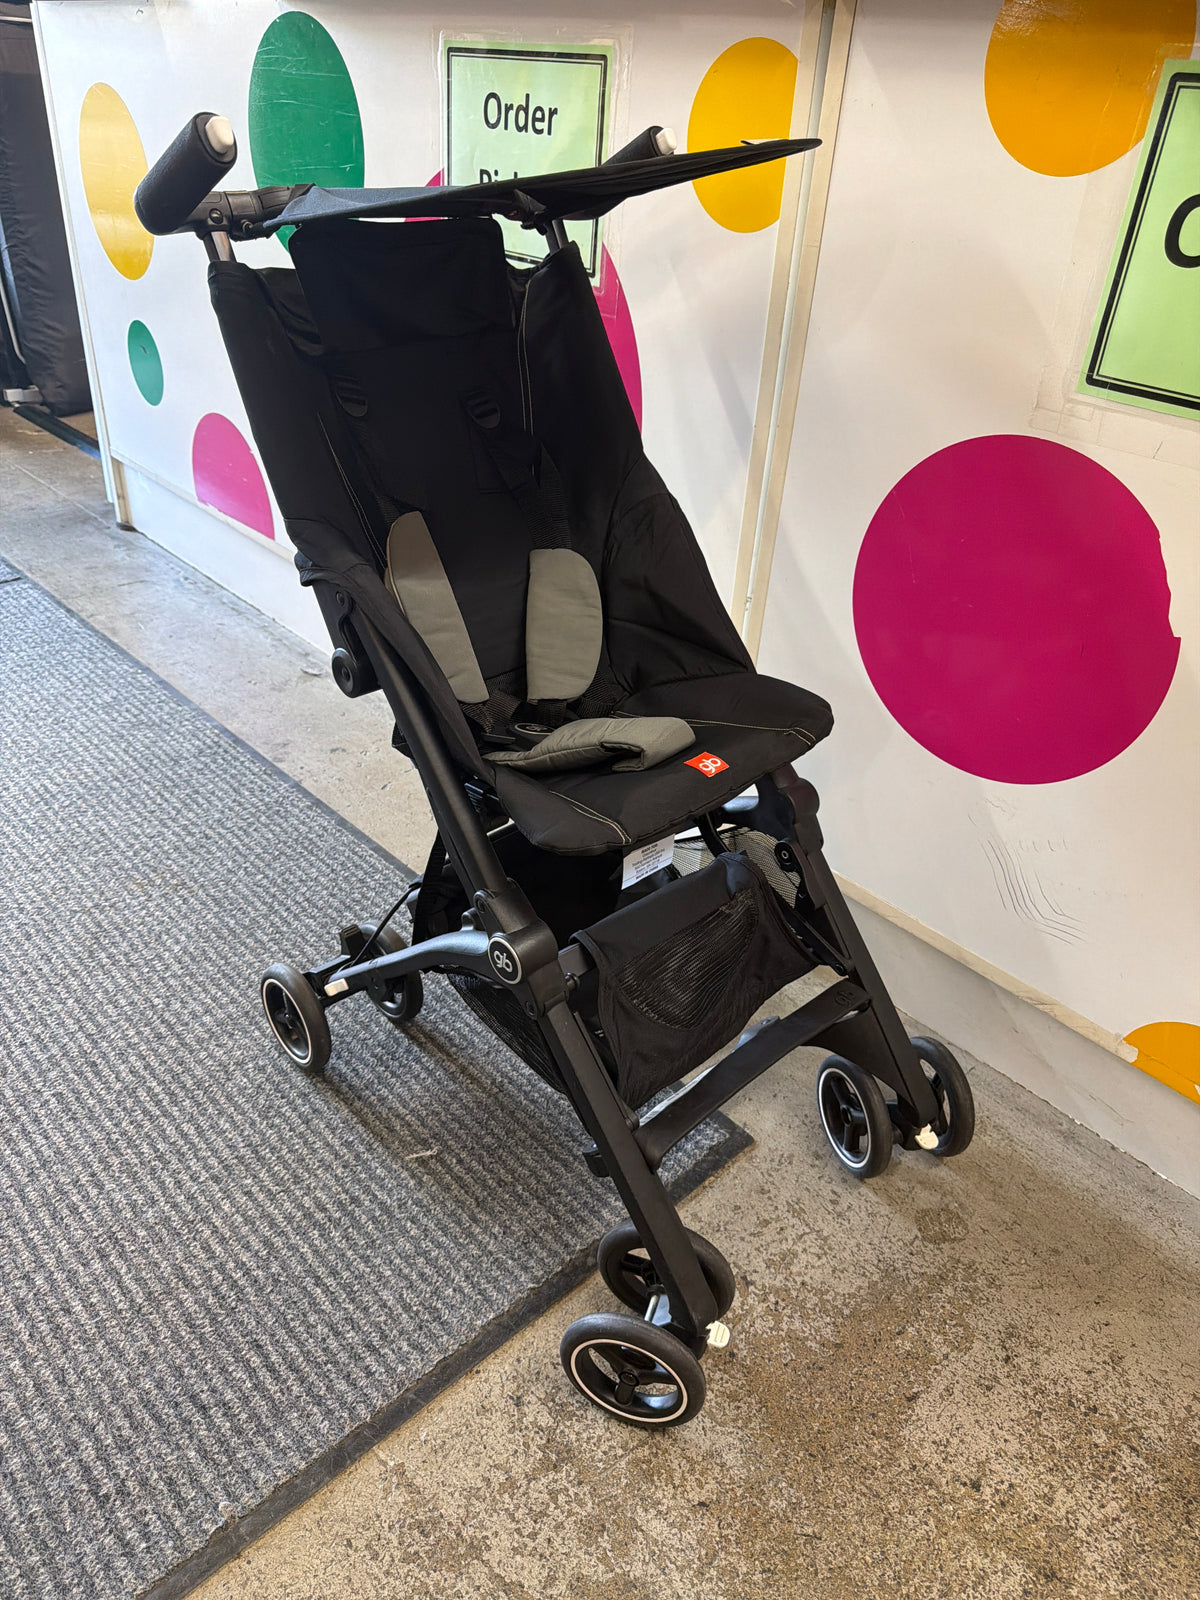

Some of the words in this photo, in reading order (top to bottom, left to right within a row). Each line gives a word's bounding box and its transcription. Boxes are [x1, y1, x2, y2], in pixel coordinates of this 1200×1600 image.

[483, 92, 558, 136] Order
[698, 757, 722, 773] gb
[493, 950, 513, 973] gb
